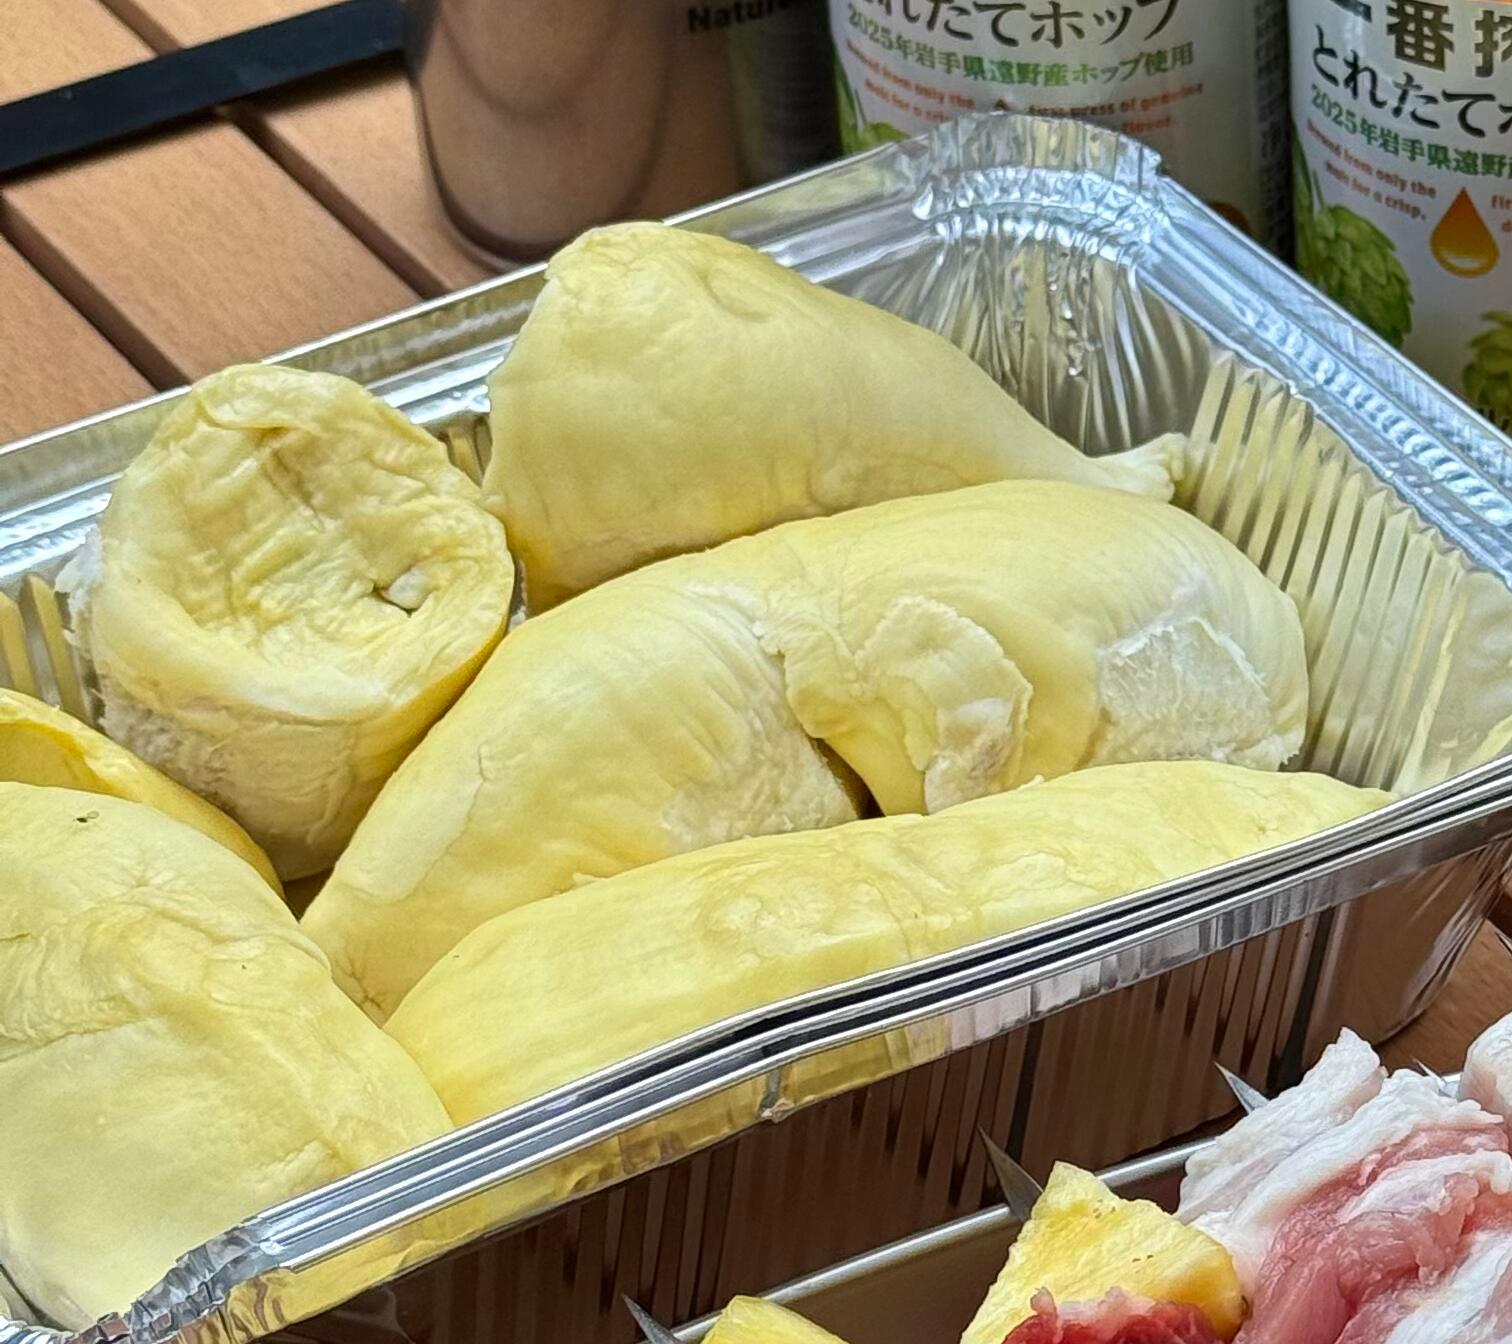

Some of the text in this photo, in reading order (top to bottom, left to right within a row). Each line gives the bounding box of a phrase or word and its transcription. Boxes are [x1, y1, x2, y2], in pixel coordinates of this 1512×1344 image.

[848, 3, 1195, 87] 2025年岩手県遠野産ホップ使用
[1375, 169, 1408, 193] only
[1410, 180, 1437, 200] the
